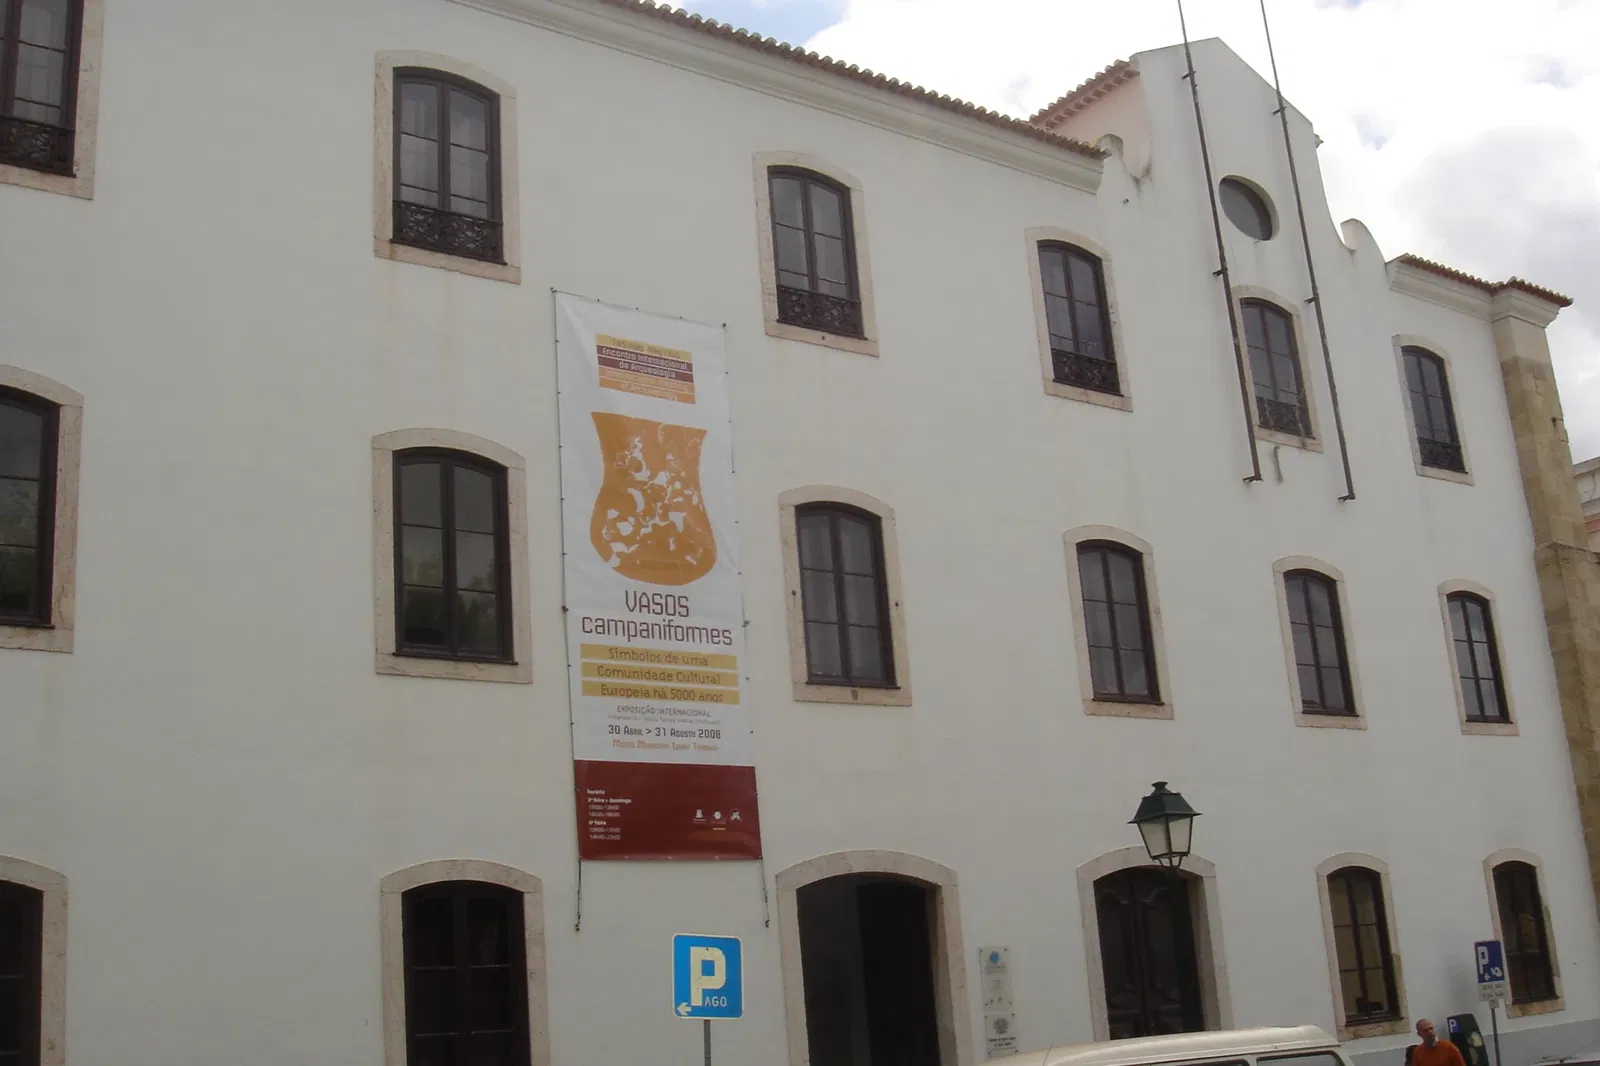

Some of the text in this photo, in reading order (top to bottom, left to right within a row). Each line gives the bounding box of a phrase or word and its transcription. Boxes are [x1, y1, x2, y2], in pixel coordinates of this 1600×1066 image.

[603, 347, 636, 360] Encontro
[638, 355, 688, 370] Internacional
[619, 361, 676, 378] de Arqueologia
[625, 589, 690, 618] VASOS
[581, 616, 733, 646] campaniformes
[665, 653, 679, 664] de
[681, 655, 709, 666] uma
[597, 665, 721, 685] Comunidade Cultural
[600, 684, 724, 703] Europeia há 5000 anos
[616, 704, 712, 718] EXPOSIÇÃO INTERNACIONAL
[608, 724, 621, 735] 30
[655, 726, 667, 737] 31
[698, 728, 721, 739] 2008
[1477, 945, 1489, 975] P
[690, 945, 726, 1007] P
[704, 995, 728, 1008] AGO
[1448, 1019, 1457, 1033] P
